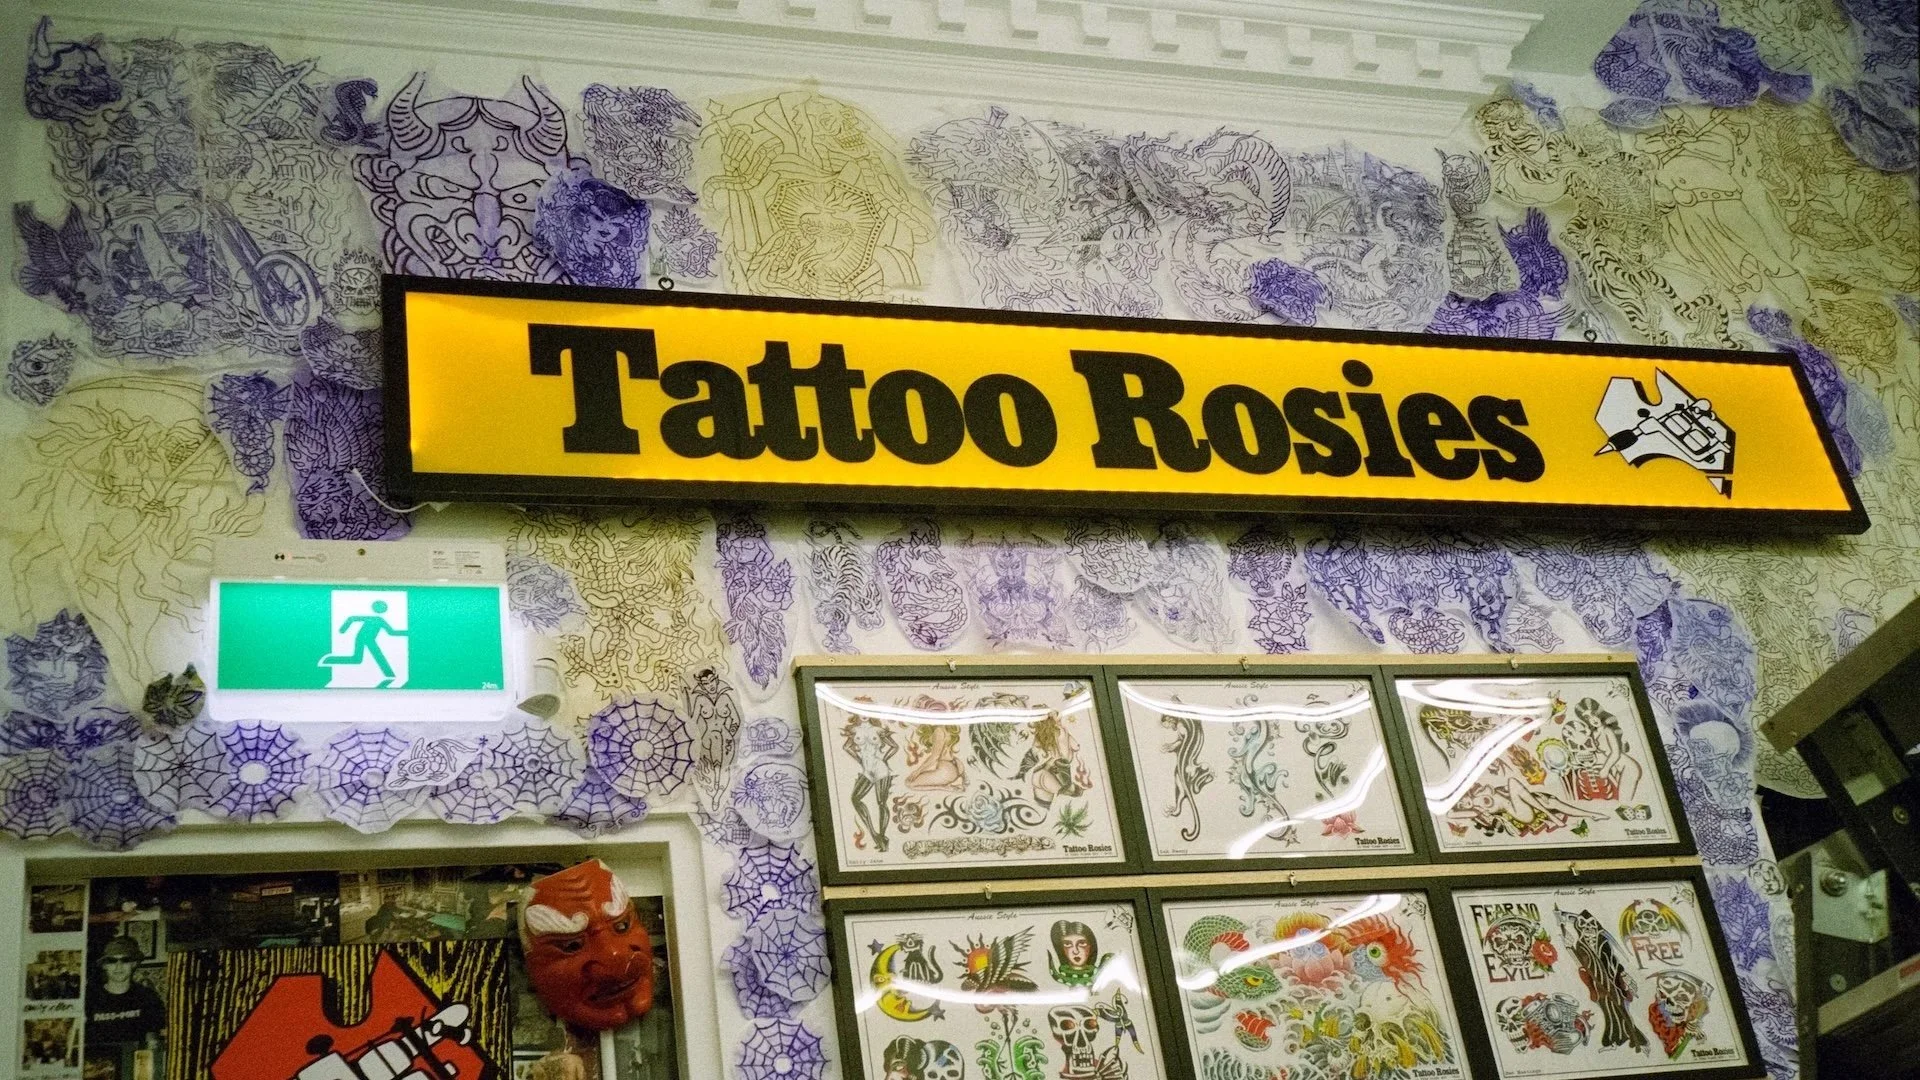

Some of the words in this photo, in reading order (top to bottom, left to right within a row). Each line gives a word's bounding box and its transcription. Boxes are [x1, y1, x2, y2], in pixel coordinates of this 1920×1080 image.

[528, 323, 1057, 467] Tattoo
[1070, 349, 1546, 482] Rosies
[481, 681, 498, 690] 24m
[1355, 837, 1377, 845] Tattoo
[1377, 836, 1400, 844] Rosies
[1063, 844, 1087, 853] Tattoo
[1087, 843, 1112, 852] Rosies
[1470, 903, 1514, 950] FEAR
[1516, 903, 1541, 921] NO
[1630, 936, 1684, 970] FREE
[1483, 953, 1545, 983] EVIL
[1691, 1049, 1713, 1057] Tattoo
[1712, 1047, 1735, 1055] Rosies
[1412, 1069, 1436, 1077] Tattoo
[1436, 1067, 1460, 1076] Rosies
